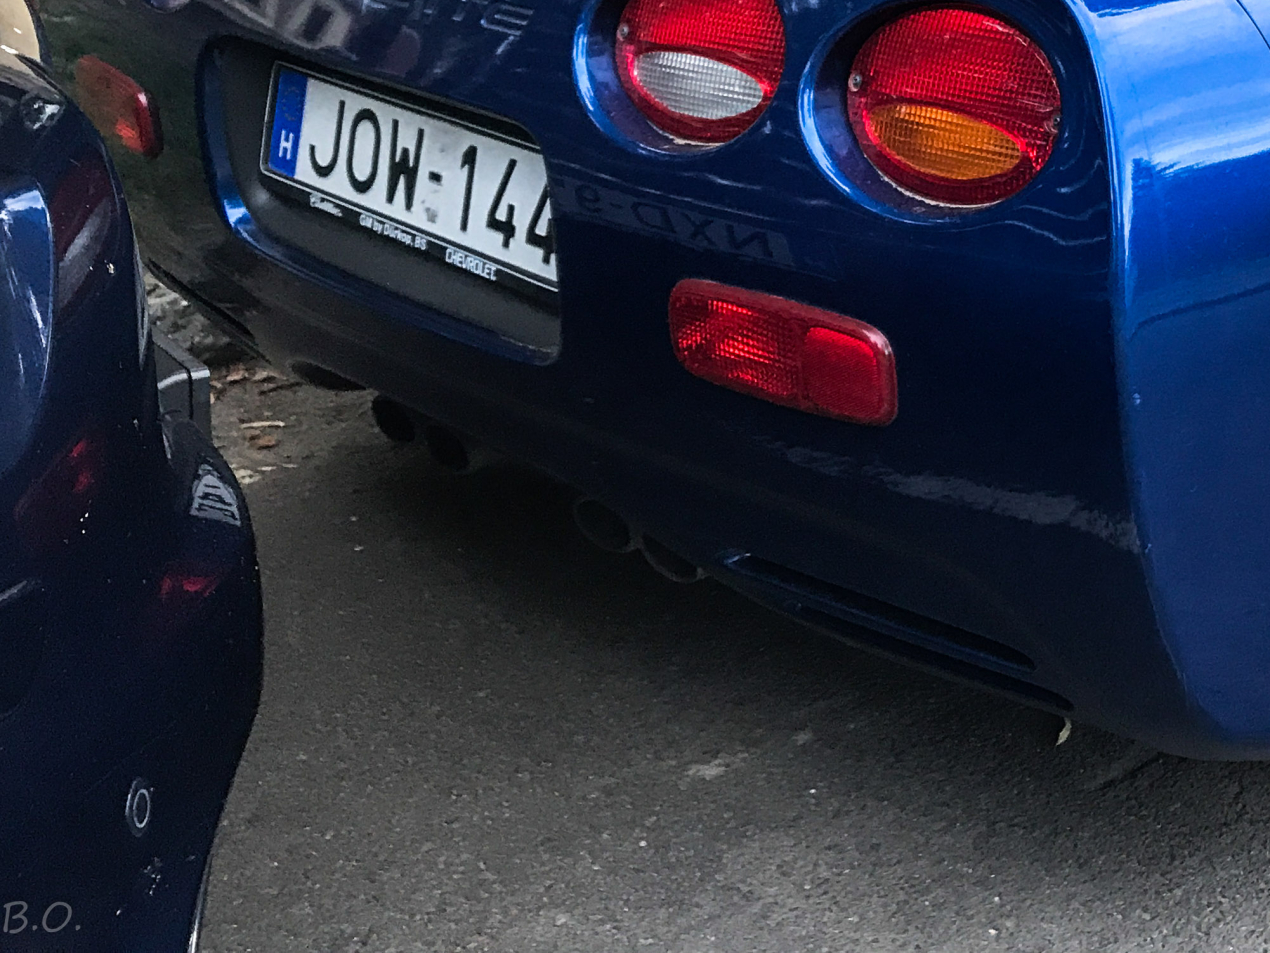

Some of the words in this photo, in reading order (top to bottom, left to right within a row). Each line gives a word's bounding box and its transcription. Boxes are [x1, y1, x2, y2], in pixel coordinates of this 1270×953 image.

[278, 129, 295, 161] H
[308, 99, 557, 266] JOW-144
[359, 213, 373, 230] GM
[373, 220, 383, 234] by
[445, 248, 497, 281] CHEVROLET
